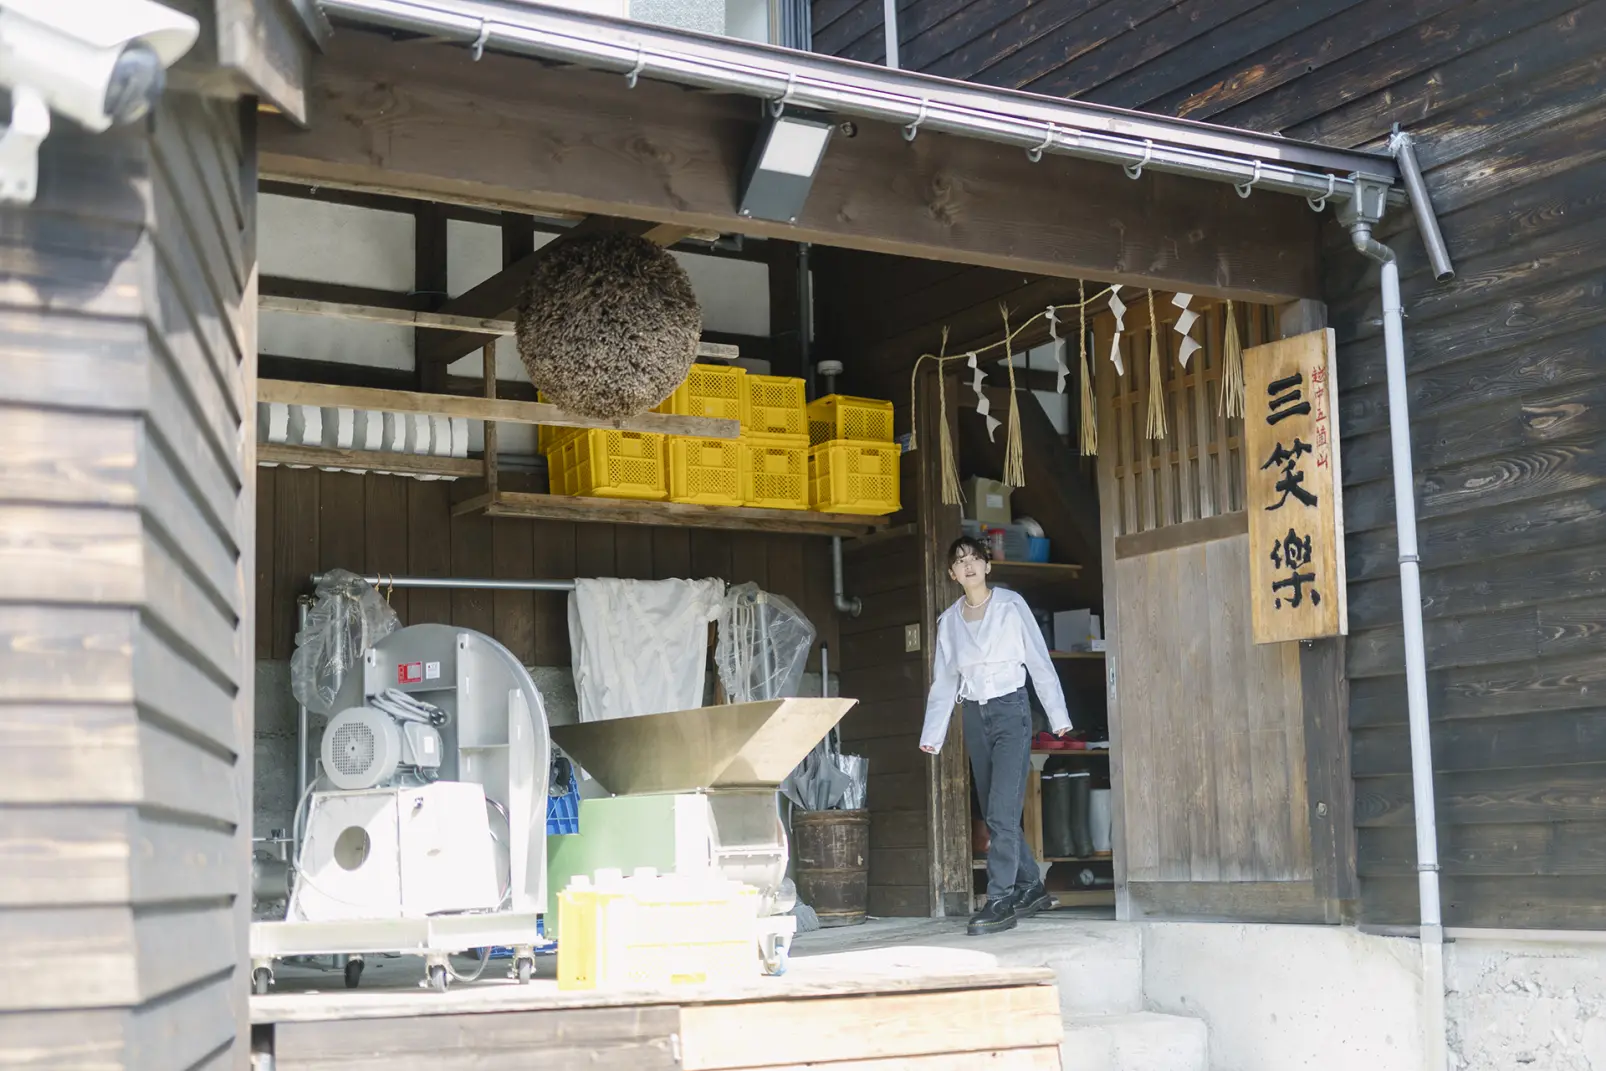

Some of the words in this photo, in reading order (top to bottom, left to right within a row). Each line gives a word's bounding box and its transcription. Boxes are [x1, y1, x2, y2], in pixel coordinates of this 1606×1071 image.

[1260, 372, 1321, 610] 三笑樂
[1311, 365, 1329, 470] 越中五箇山
